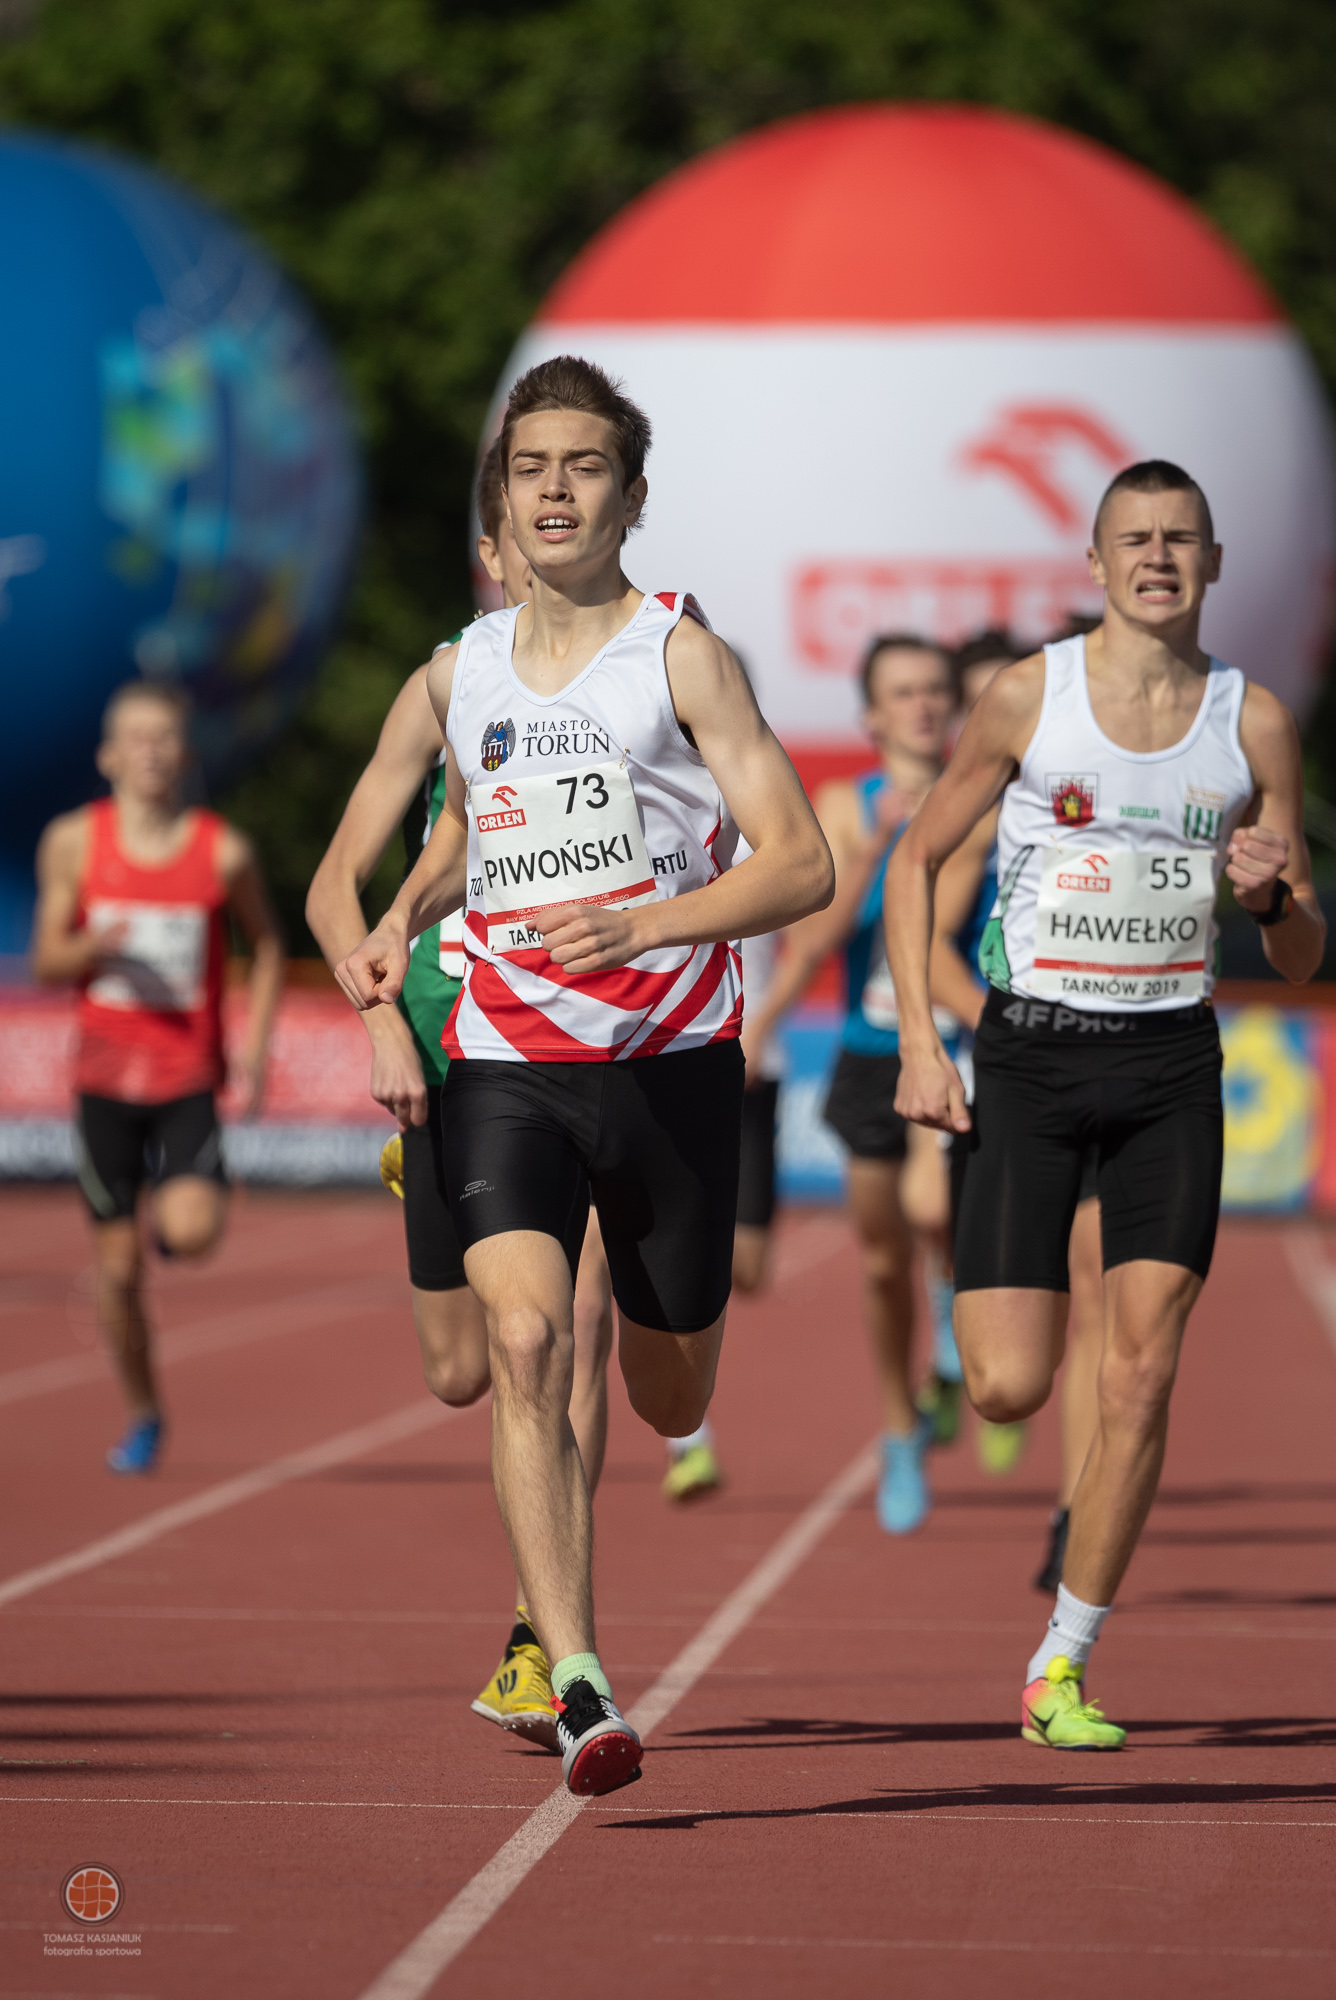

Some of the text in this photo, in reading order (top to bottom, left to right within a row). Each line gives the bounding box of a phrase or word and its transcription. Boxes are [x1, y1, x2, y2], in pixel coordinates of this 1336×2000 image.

[526, 719, 590, 734] MIASTO
[521, 727, 610, 757] TORUŃ
[556, 773, 609, 814] 73
[478, 812, 523, 830] ORLEN
[484, 833, 633, 888] PIWOŃSKI
[651, 850, 687, 875] RTU
[1150, 857, 1191, 890] 55
[1059, 875, 1109, 891] ORLEN
[1050, 913, 1198, 943] HAWEŁKO
[1061, 976, 1180, 996] TARNÓW 2019
